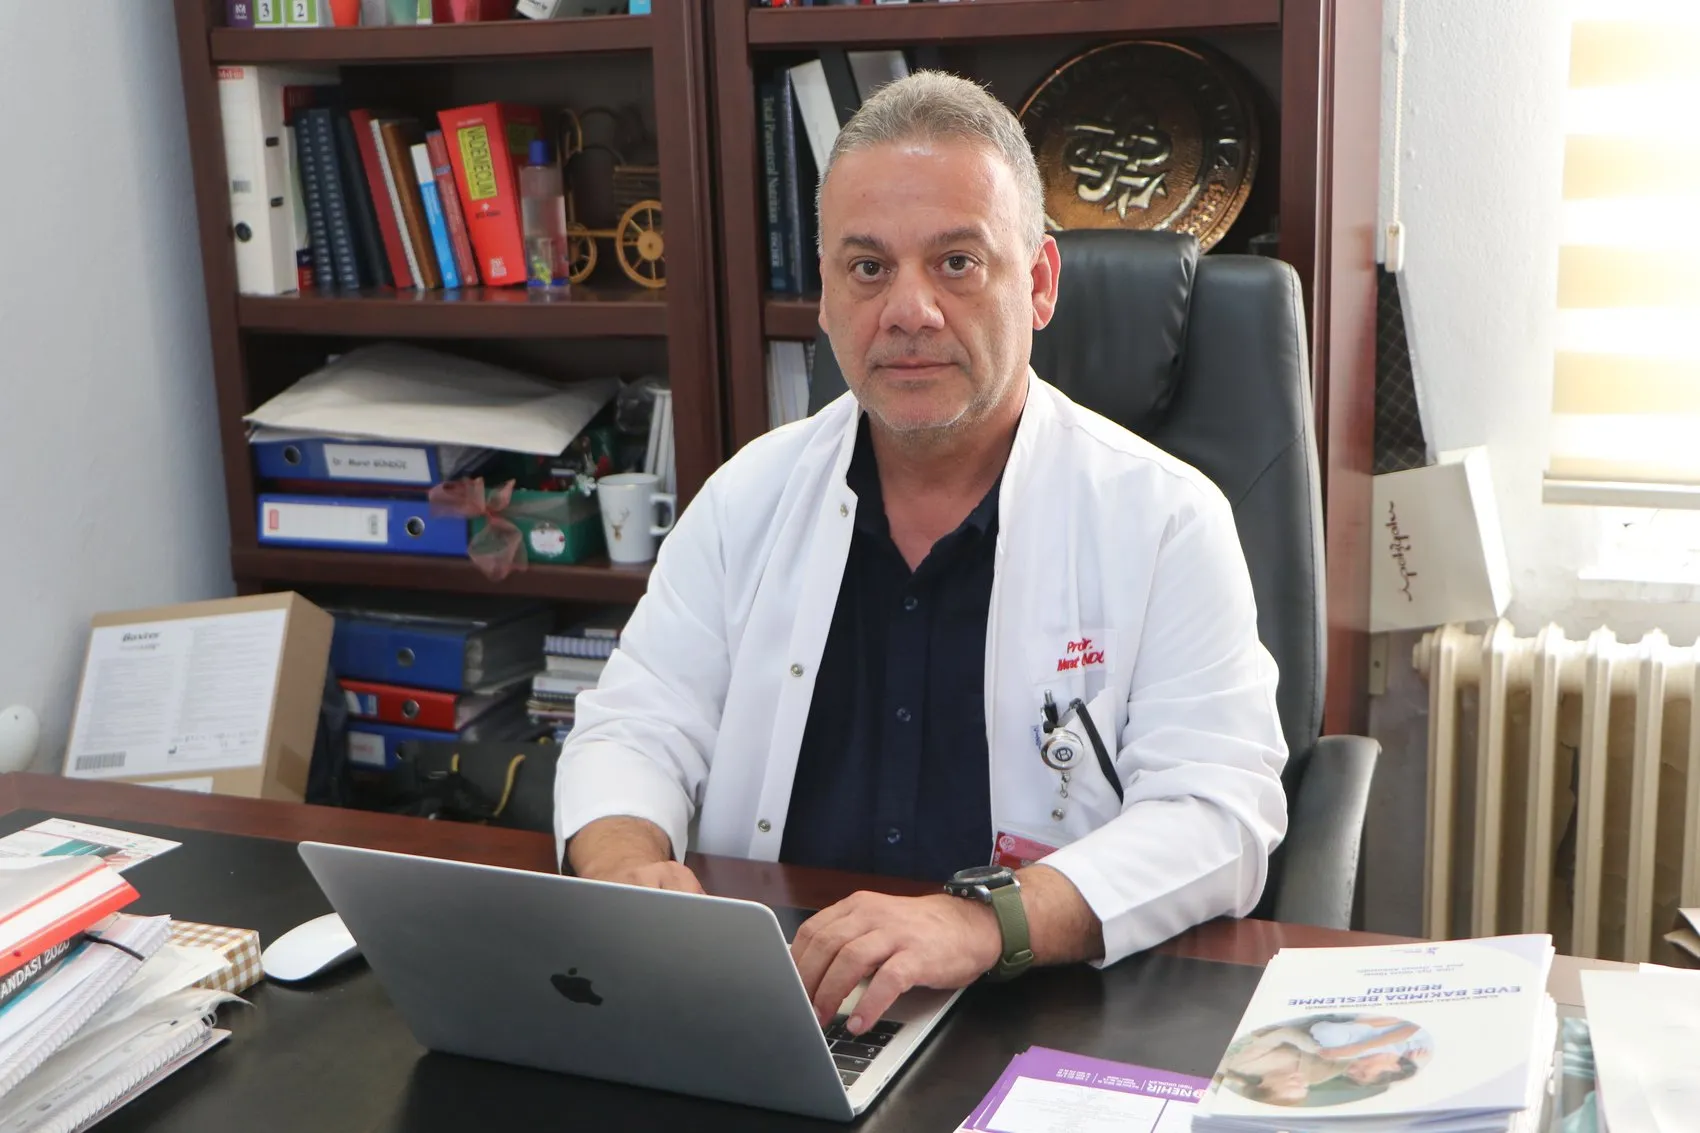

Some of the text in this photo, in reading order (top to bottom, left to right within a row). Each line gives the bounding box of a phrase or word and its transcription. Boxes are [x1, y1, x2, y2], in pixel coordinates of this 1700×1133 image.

[262, 3, 270, 17] 3
[296, 3, 305, 17] 2
[763, 97, 776, 121] Total
[467, 126, 494, 196] VADEMECUM
[768, 177, 780, 223] Nutrition
[122, 631, 162, 642] Baxter
[1288, 986, 1521, 1006] EVDE BAKIMDA BESLENME
[1367, 984, 1443, 995] REHBERİ
[1147, 1084, 1193, 1097] NEHİR
